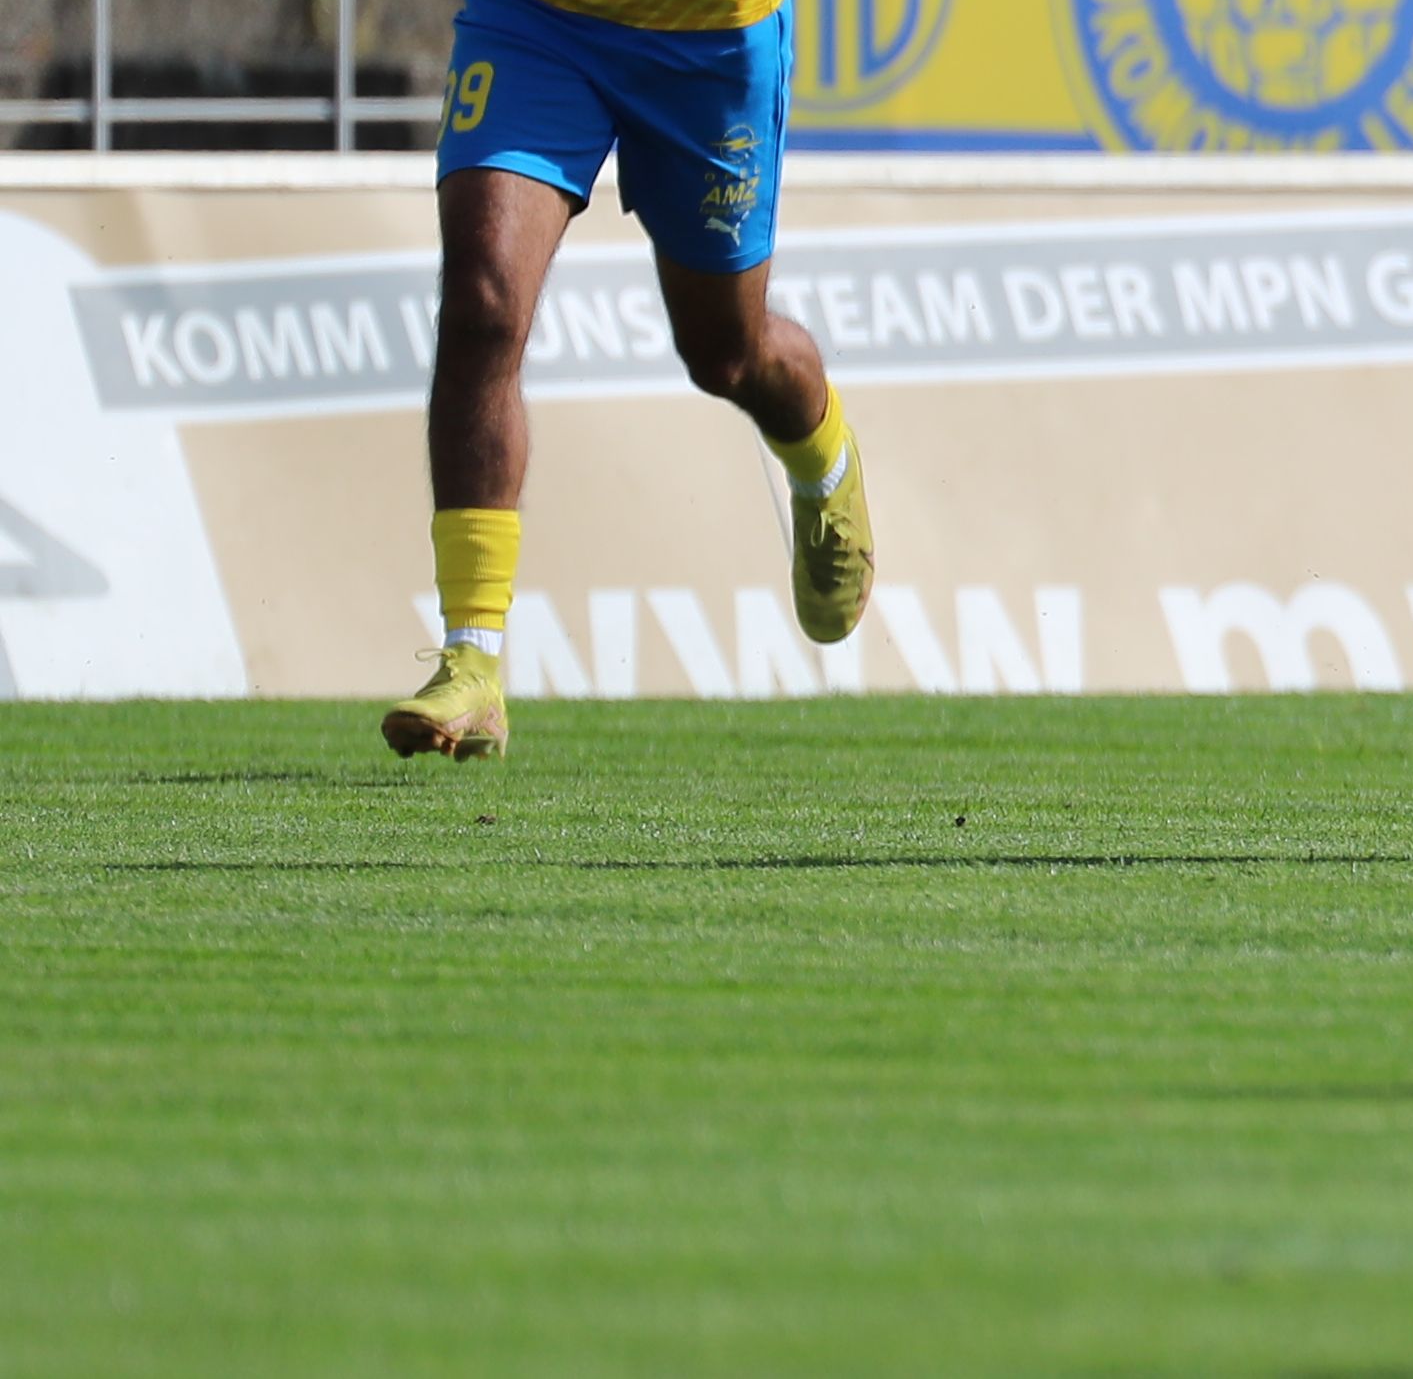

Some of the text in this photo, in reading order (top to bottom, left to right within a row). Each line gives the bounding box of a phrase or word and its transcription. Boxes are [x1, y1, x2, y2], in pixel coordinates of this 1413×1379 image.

[121, 301, 390, 389] KOMM
[400, 293, 442, 370] I
[768, 269, 993, 349] TEAM
[1002, 262, 1167, 345] DER
[1173, 253, 1358, 336] MPN
